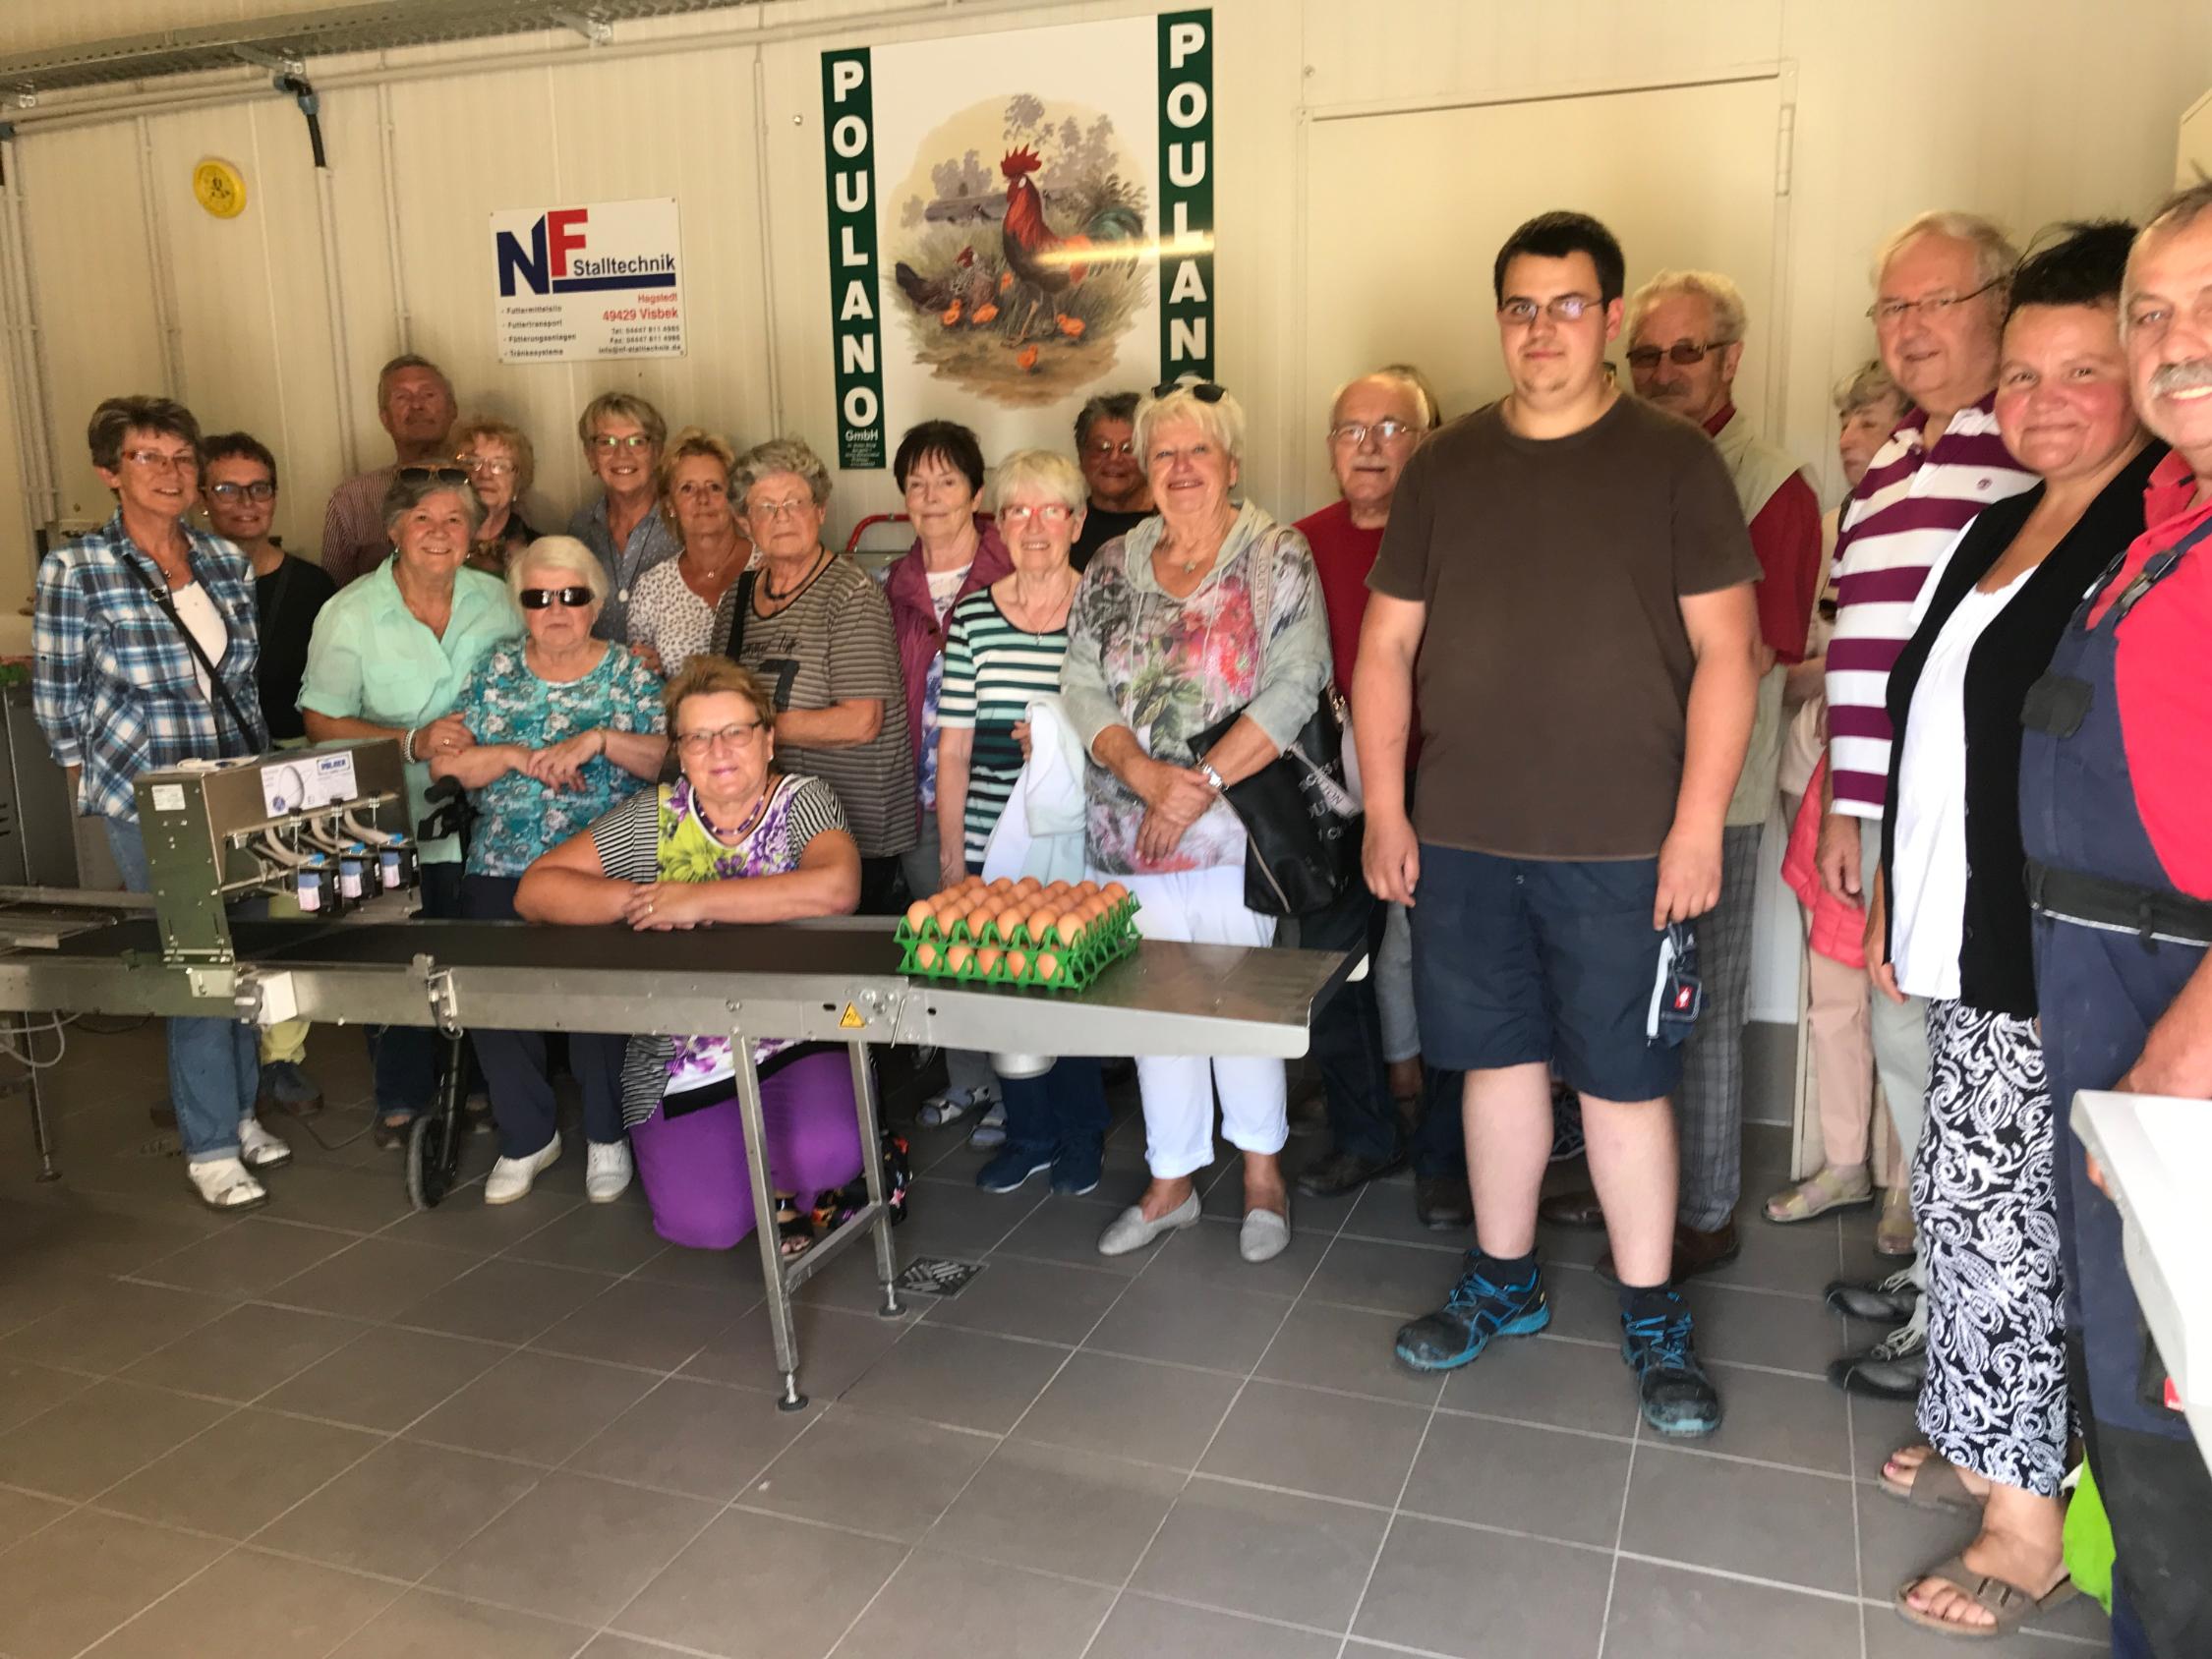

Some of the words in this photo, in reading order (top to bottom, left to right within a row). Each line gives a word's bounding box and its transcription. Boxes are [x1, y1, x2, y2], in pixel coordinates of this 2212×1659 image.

[1166, 22, 1207, 362] POULAN
[496, 208, 588, 297] NF
[573, 254, 676, 277] Stalltechnik
[832, 60, 878, 428] POULANO
[603, 309, 637, 322] 49429
[640, 307, 678, 320] Visbek
[844, 429, 879, 441] GmbH
